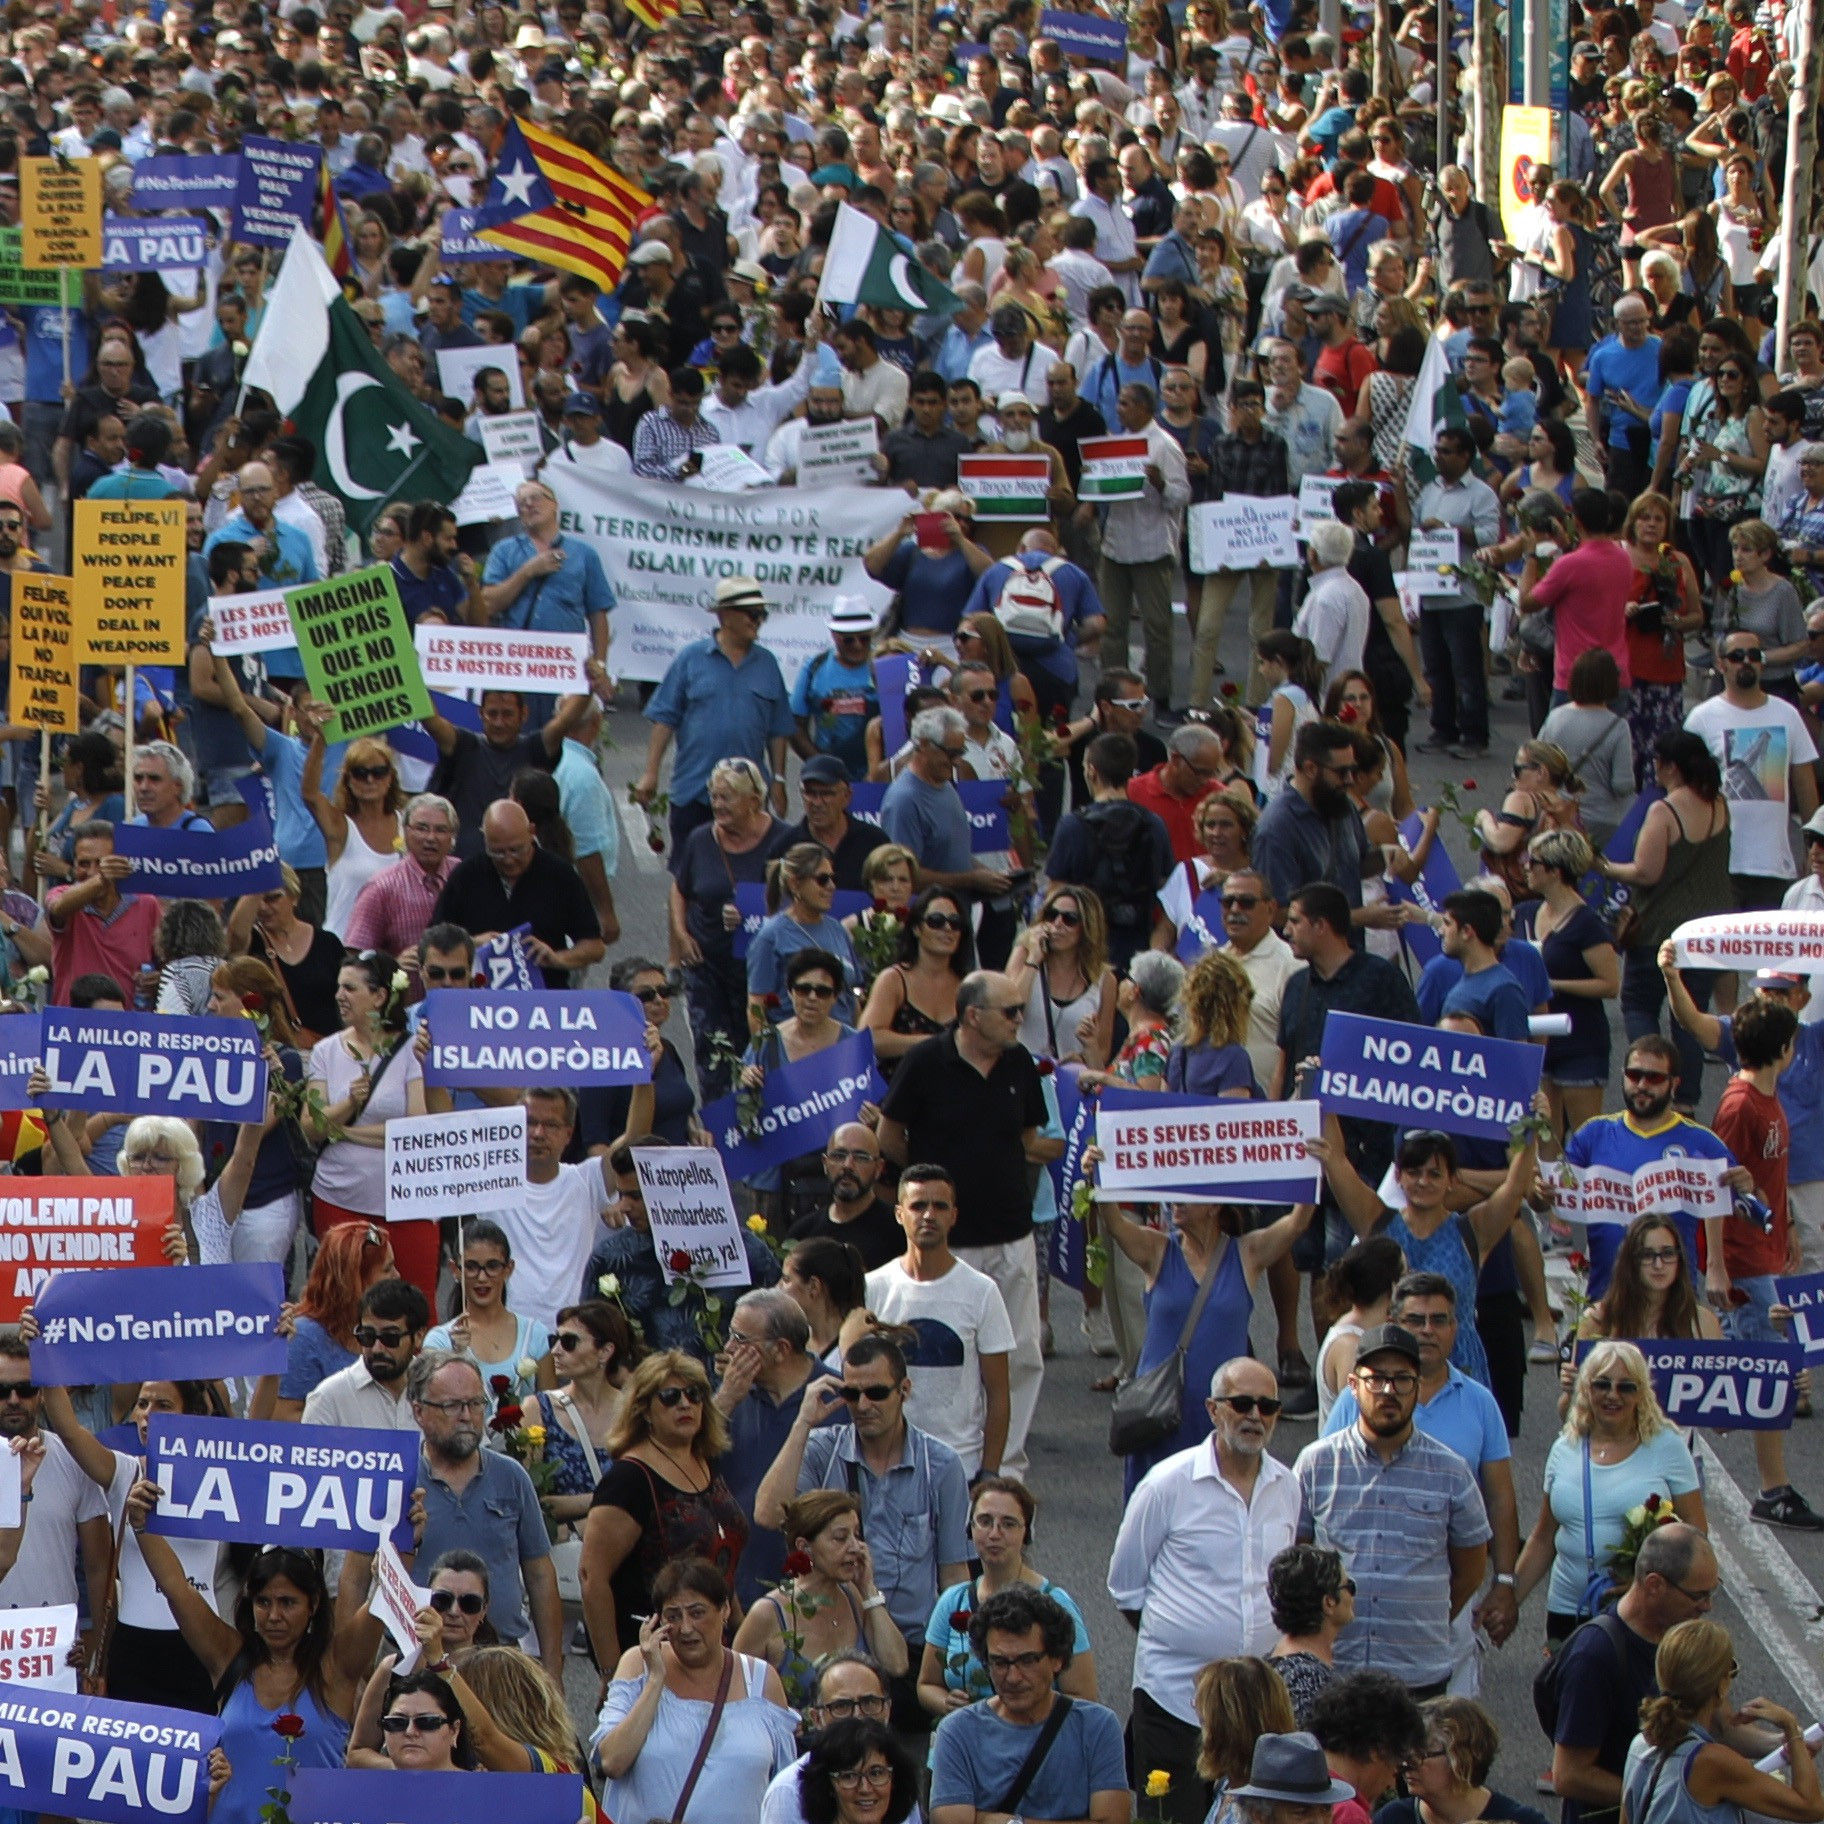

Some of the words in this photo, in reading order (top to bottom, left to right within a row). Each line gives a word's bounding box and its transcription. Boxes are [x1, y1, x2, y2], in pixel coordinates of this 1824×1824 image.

[101, 511, 159, 526] FELIPE,
[98, 533, 160, 546] PEOPLE
[559, 510, 585, 534] EL
[593, 514, 740, 549] TERRORISME
[746, 532, 784, 552] NO
[82, 554, 122, 567] WHO
[126, 554, 177, 567] WANT
[627, 549, 695, 577] ISLAM
[701, 557, 743, 579] VOL
[754, 562, 793, 586] DIR
[797, 565, 843, 586] PAU
[102, 576, 156, 589] PEACE
[104, 597, 154, 610] DON'T
[97, 618, 140, 631] DEAL
[143, 619, 160, 631] IN
[87, 640, 171, 653] WEAPONS
[470, 1006, 519, 1030] NO
[528, 1006, 551, 1030] A
[560, 1007, 597, 1030] LA
[433, 1040, 644, 1070] ISLAMOFÒBIA
[391, 1129, 468, 1152] TENEMOS
[471, 1124, 523, 1144] MIEDO
[1116, 1127, 1148, 1147] LES
[1155, 1123, 1210, 1144] SEVES
[1215, 1118, 1303, 1141] GUERRES,
[391, 1160, 402, 1176] A
[405, 1152, 480, 1174] NUESTROS
[1115, 1151, 1148, 1170] ELS
[1153, 1145, 1237, 1168] NOSTRES
[1242, 1138, 1309, 1163] MORTS
[639, 1161, 655, 1184] Ni
[391, 1184, 411, 1200] No
[415, 1185, 439, 1198] nos
[82, 1197, 138, 1228] PAU,
[650, 1203, 662, 1226] ni
[32, 1232, 135, 1261] VENDRE
[159, 1436, 188, 1457] LA
[194, 1439, 283, 1464] MILLOR
[291, 1446, 404, 1472] RESPOSTA
[157, 1463, 240, 1522] LA
[265, 1471, 403, 1534] PAU
